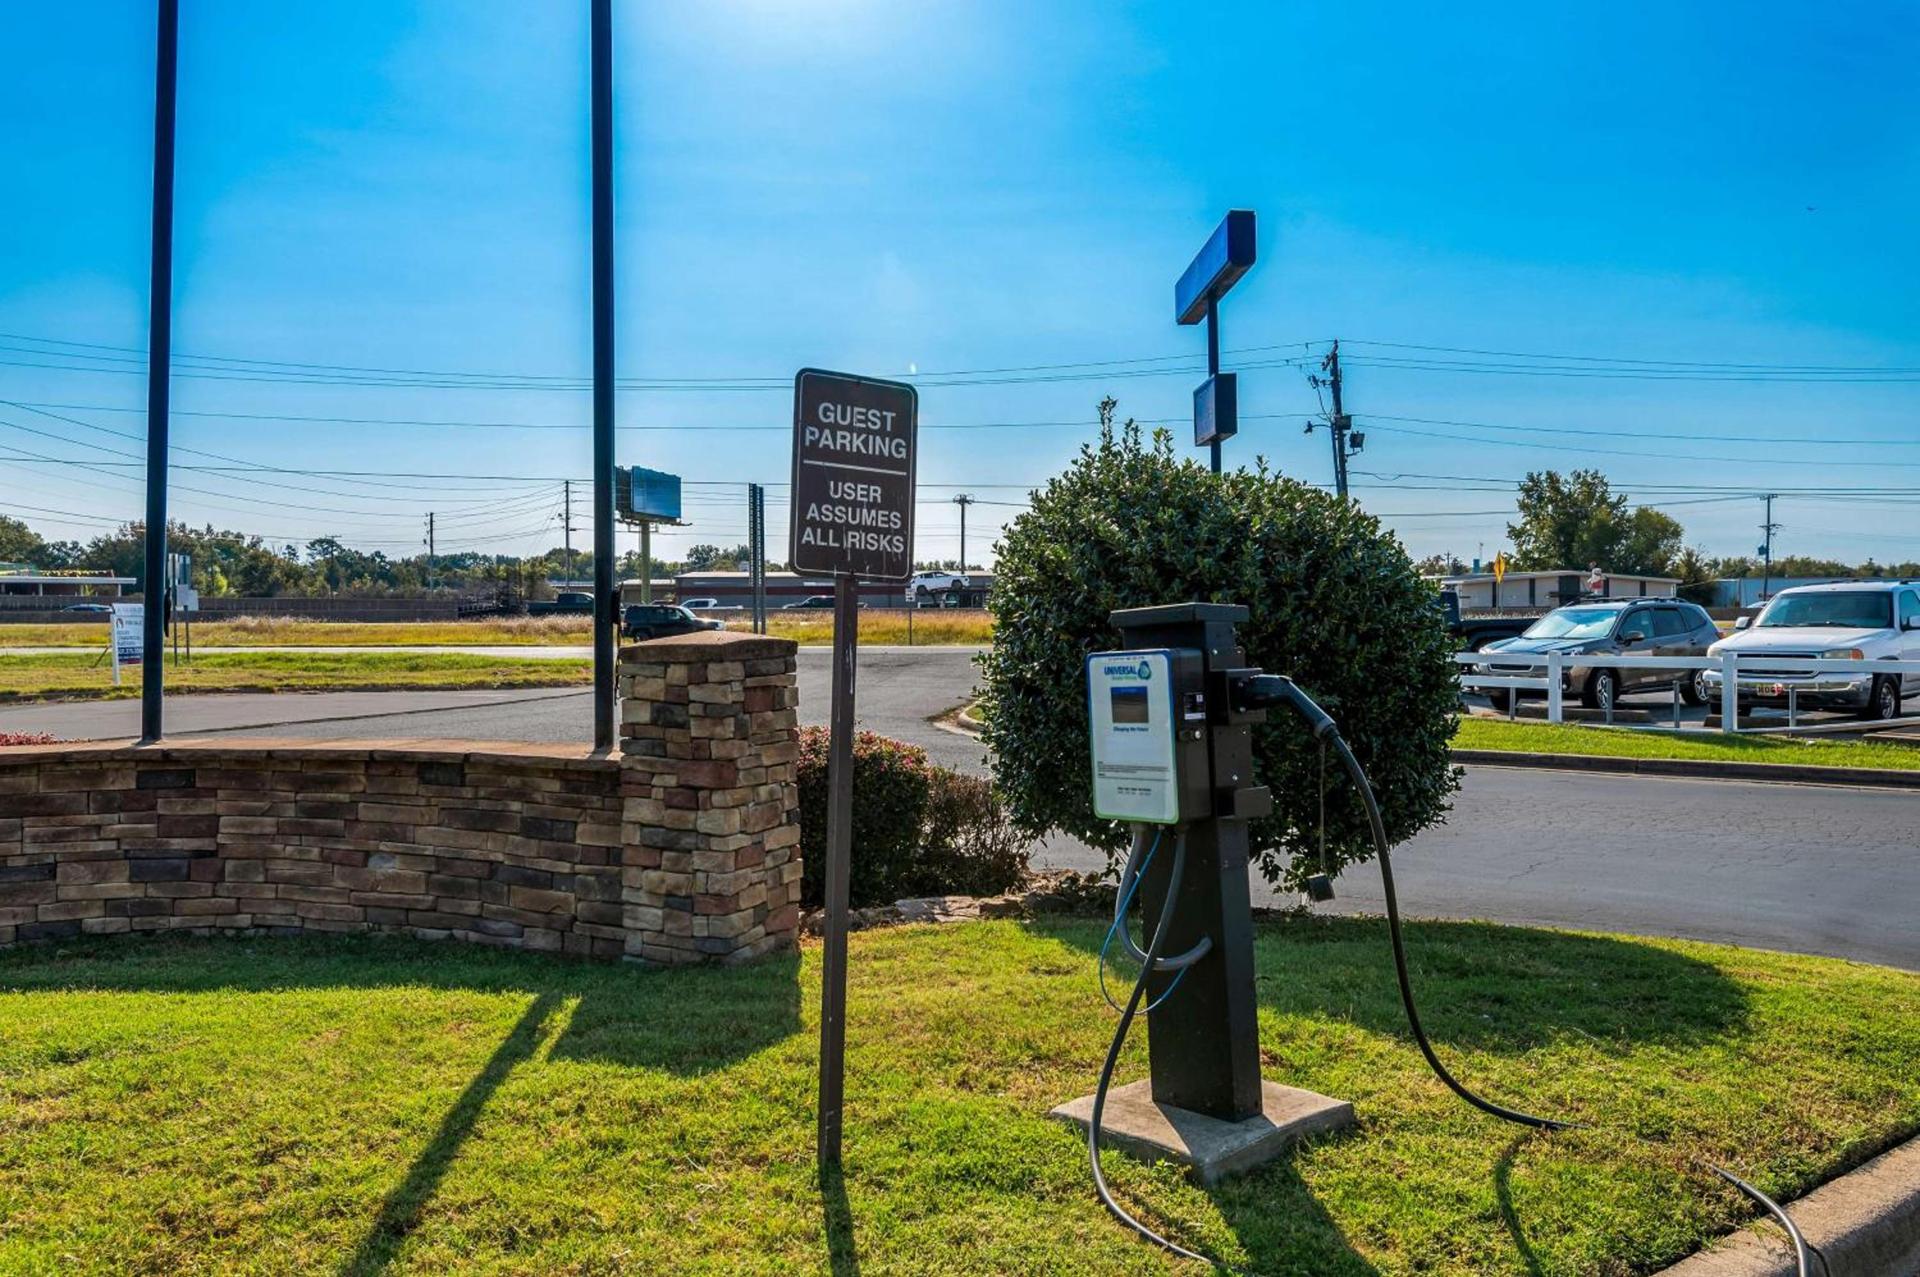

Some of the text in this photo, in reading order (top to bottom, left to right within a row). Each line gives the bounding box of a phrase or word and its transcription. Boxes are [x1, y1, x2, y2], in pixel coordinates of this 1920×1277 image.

[818, 402, 896, 432] GUEST
[804, 426, 907, 459] PARKING
[829, 480, 882, 503] USER
[806, 502, 902, 529] ASSUMES
[801, 527, 905, 553] ALL RISKS
[1104, 665, 1137, 675] UNIVERSAL
